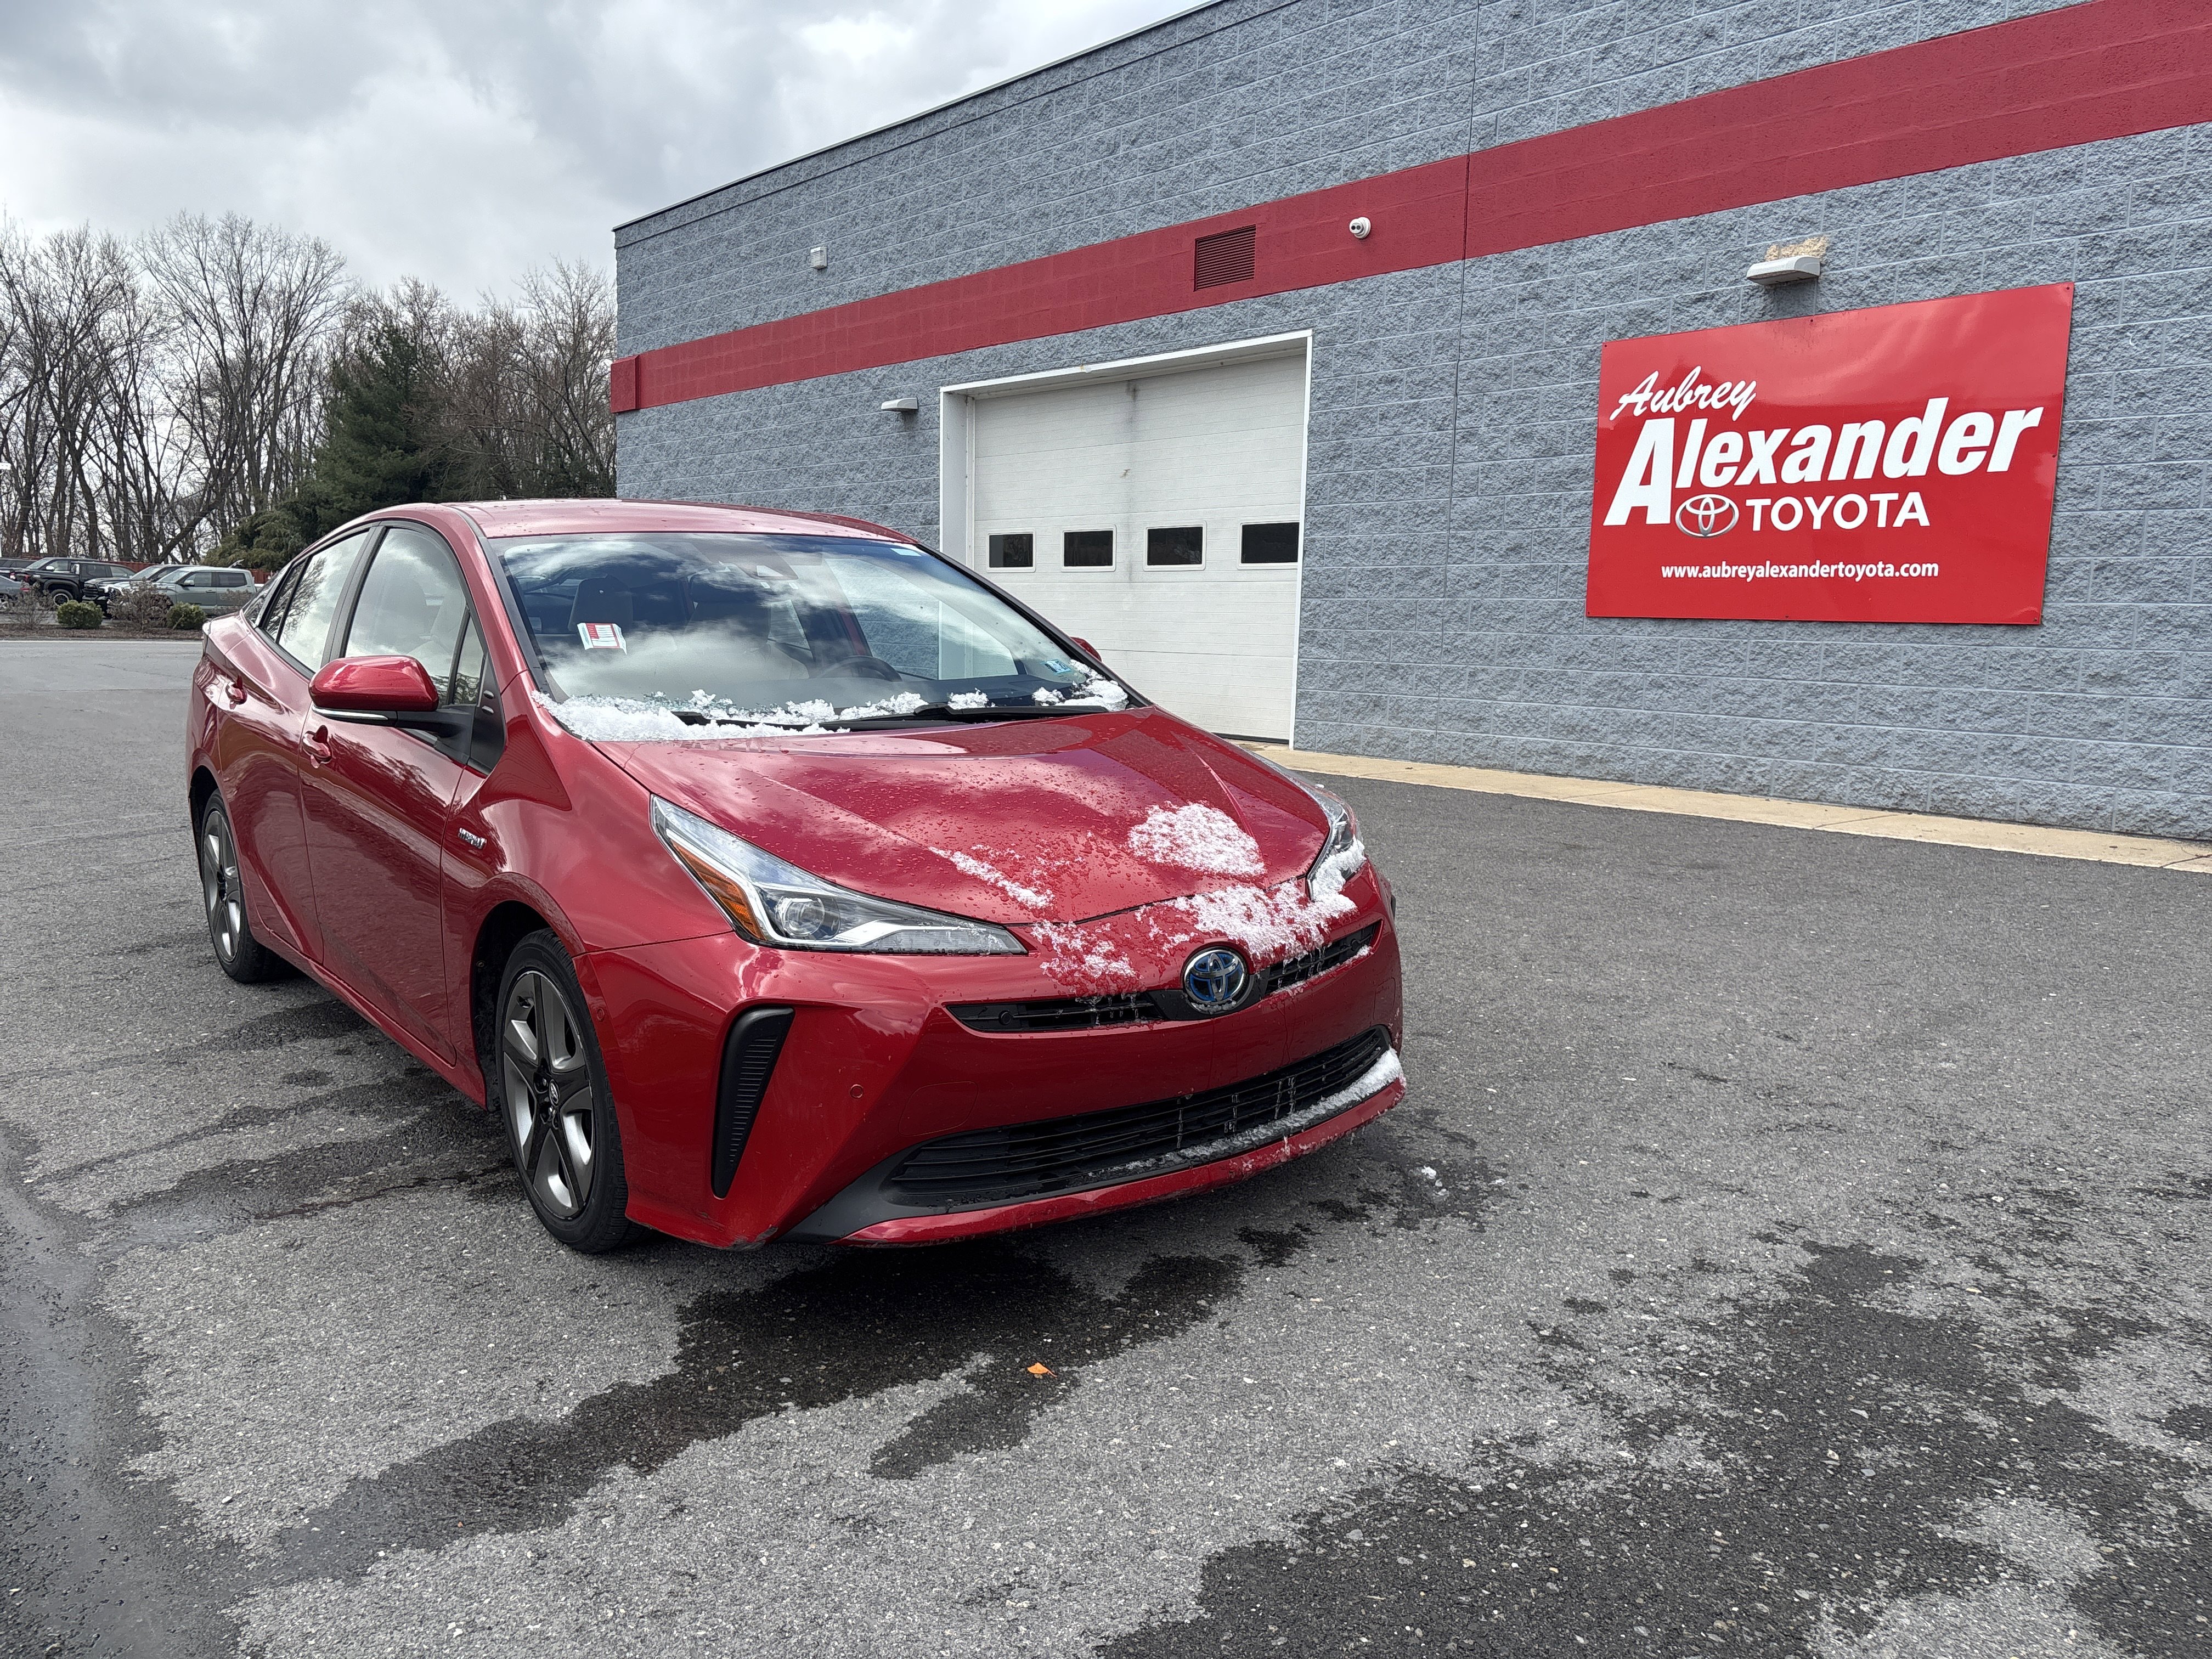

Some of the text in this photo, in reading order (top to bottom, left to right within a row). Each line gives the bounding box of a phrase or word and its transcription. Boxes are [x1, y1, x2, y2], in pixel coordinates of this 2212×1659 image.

[1609, 365, 1757, 421] Aubrey
[1602, 397, 2044, 526] Alexander
[1745, 492, 1931, 531] TOYOTA
[1661, 560, 1939, 582] www.aubreyalexandertoyota.com
